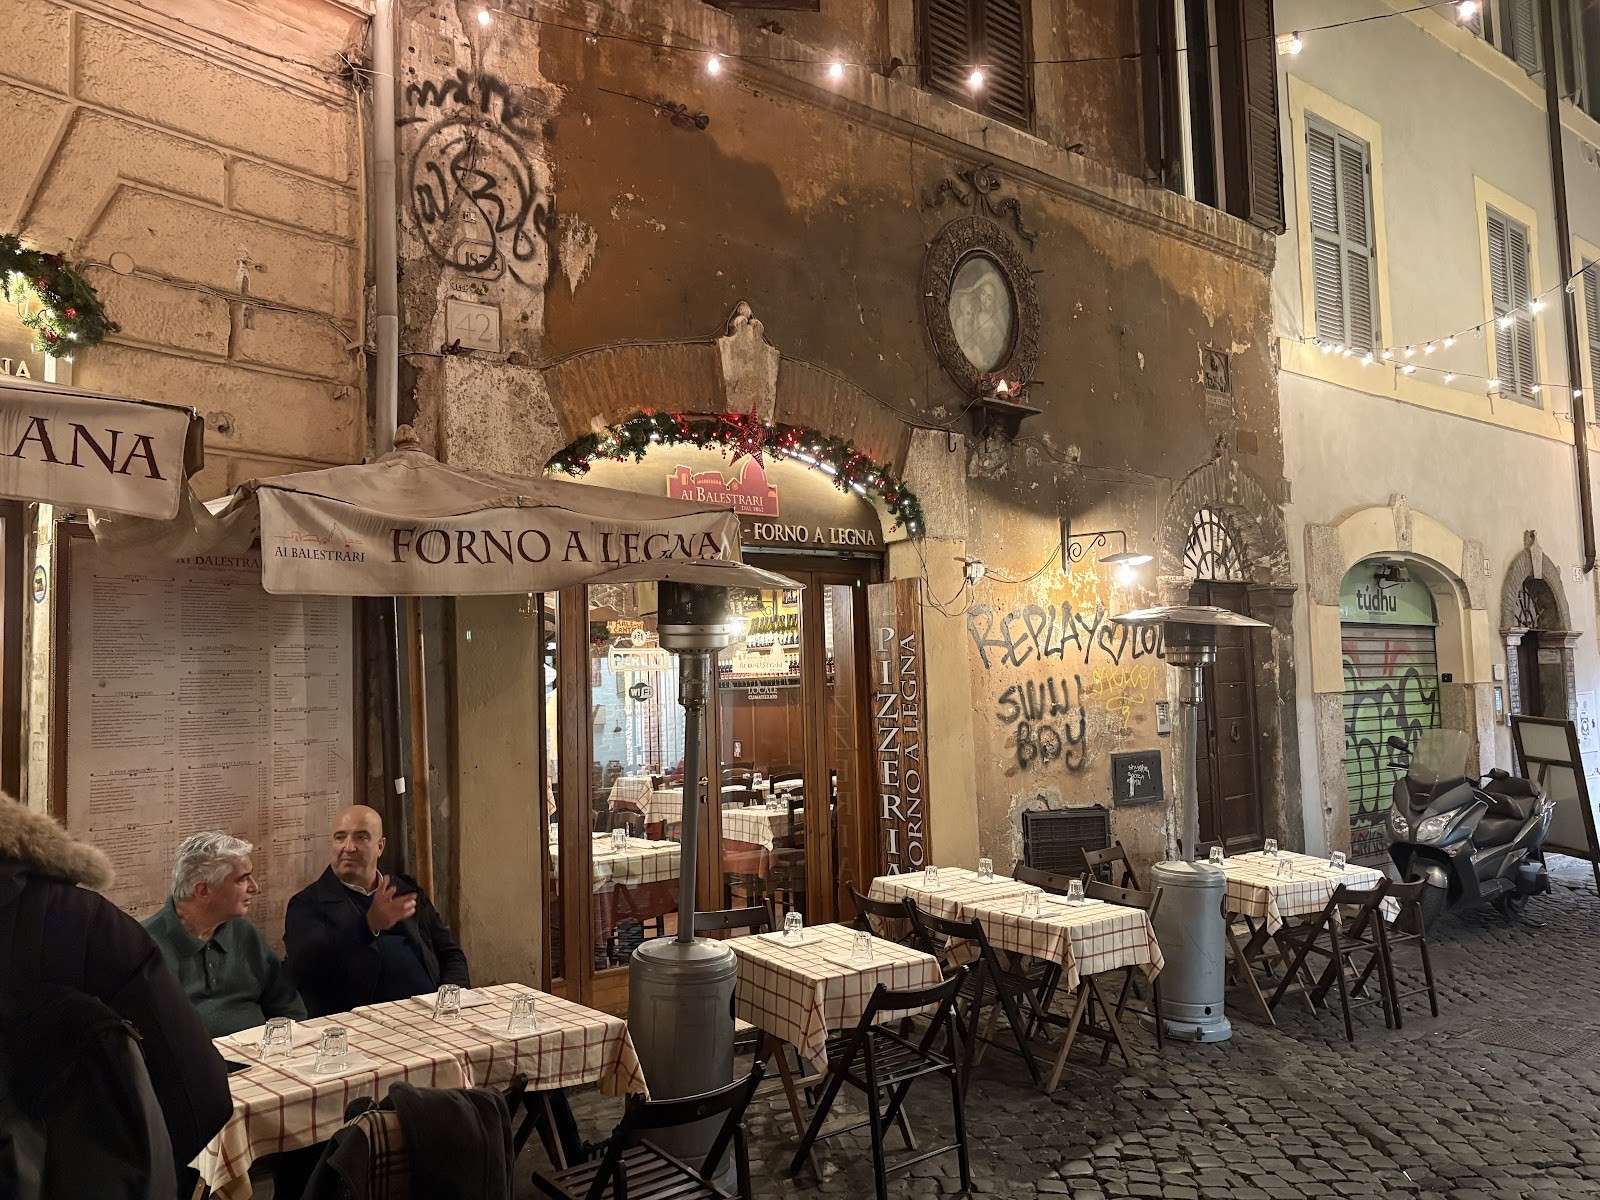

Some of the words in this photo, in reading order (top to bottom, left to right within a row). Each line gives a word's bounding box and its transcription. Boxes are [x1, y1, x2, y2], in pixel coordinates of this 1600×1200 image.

[456, 313, 493, 342] 42
[0, 416, 167, 480] ANA
[681, 489, 693, 501] AI
[695, 486, 764, 507] BALESTRARI
[390, 527, 551, 565] FORNO
[562, 530, 592, 563] A
[599, 530, 723, 565] LEGNA
[753, 522, 809, 542] FORNO
[813, 526, 825, 544] A
[829, 527, 876, 546] LEGNA
[274, 546, 287, 557] AI
[291, 547, 365, 562] BALESTRARI
[1356, 585, 1397, 612] túdhu
[967, 600, 1108, 669] REPLAY
[748, 686, 778, 695] LOCALE
[899, 631, 919, 733] LEGNA
[875, 627, 906, 876] PIZZERIA
[904, 743, 920, 760] A
[1016, 718, 1087, 770] BOY
[906, 769, 925, 874] ORNO
